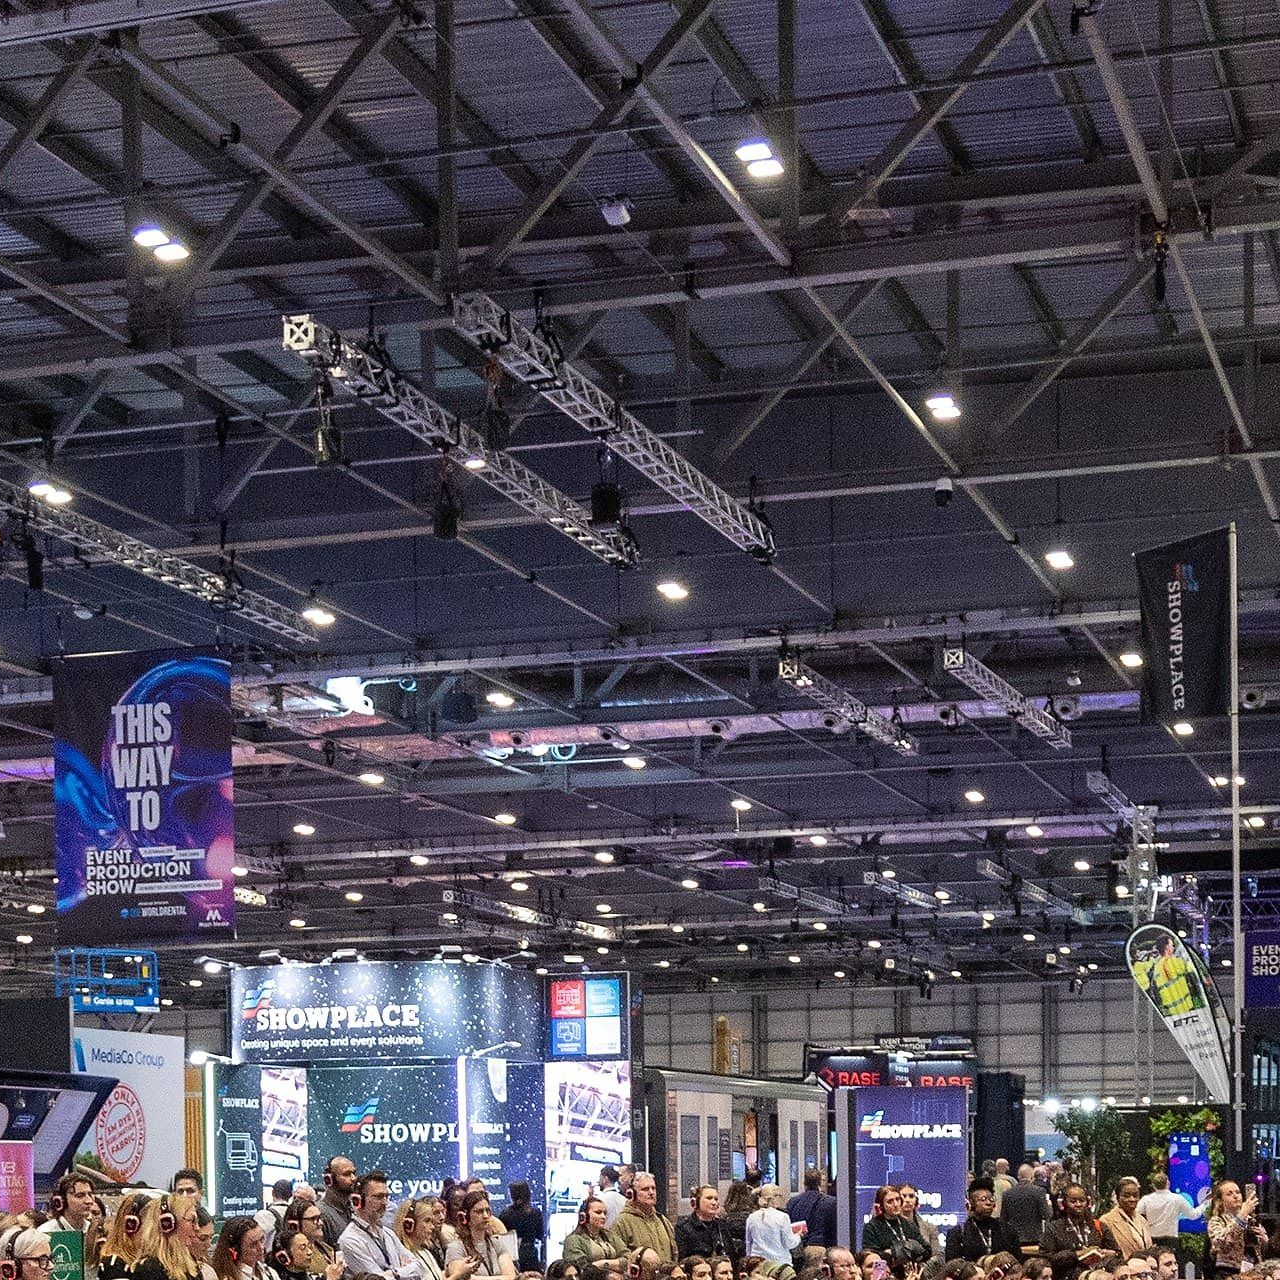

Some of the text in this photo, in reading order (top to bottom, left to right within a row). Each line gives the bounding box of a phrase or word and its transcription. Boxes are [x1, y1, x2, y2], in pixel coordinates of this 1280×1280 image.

[1166, 580, 1185, 711] SHOWPLACE
[111, 702, 173, 744] THIS
[111, 744, 174, 789] WAY
[126, 790, 161, 831] TO
[86, 850, 132, 866] EVENT
[86, 861, 191, 881] PRODUCTION
[86, 879, 135, 896] SHOW
[256, 1005, 420, 1031] SHOWPLACE
[270, 1038, 300, 1050] unique
[301, 1038, 329, 1049] space
[330, 1036, 349, 1047] and
[350, 1036, 377, 1047] event
[378, 1034, 424, 1046] solutions
[91, 1048, 165, 1069] MediaCo Group
[222, 1097, 259, 1109] SHOWPLACE
